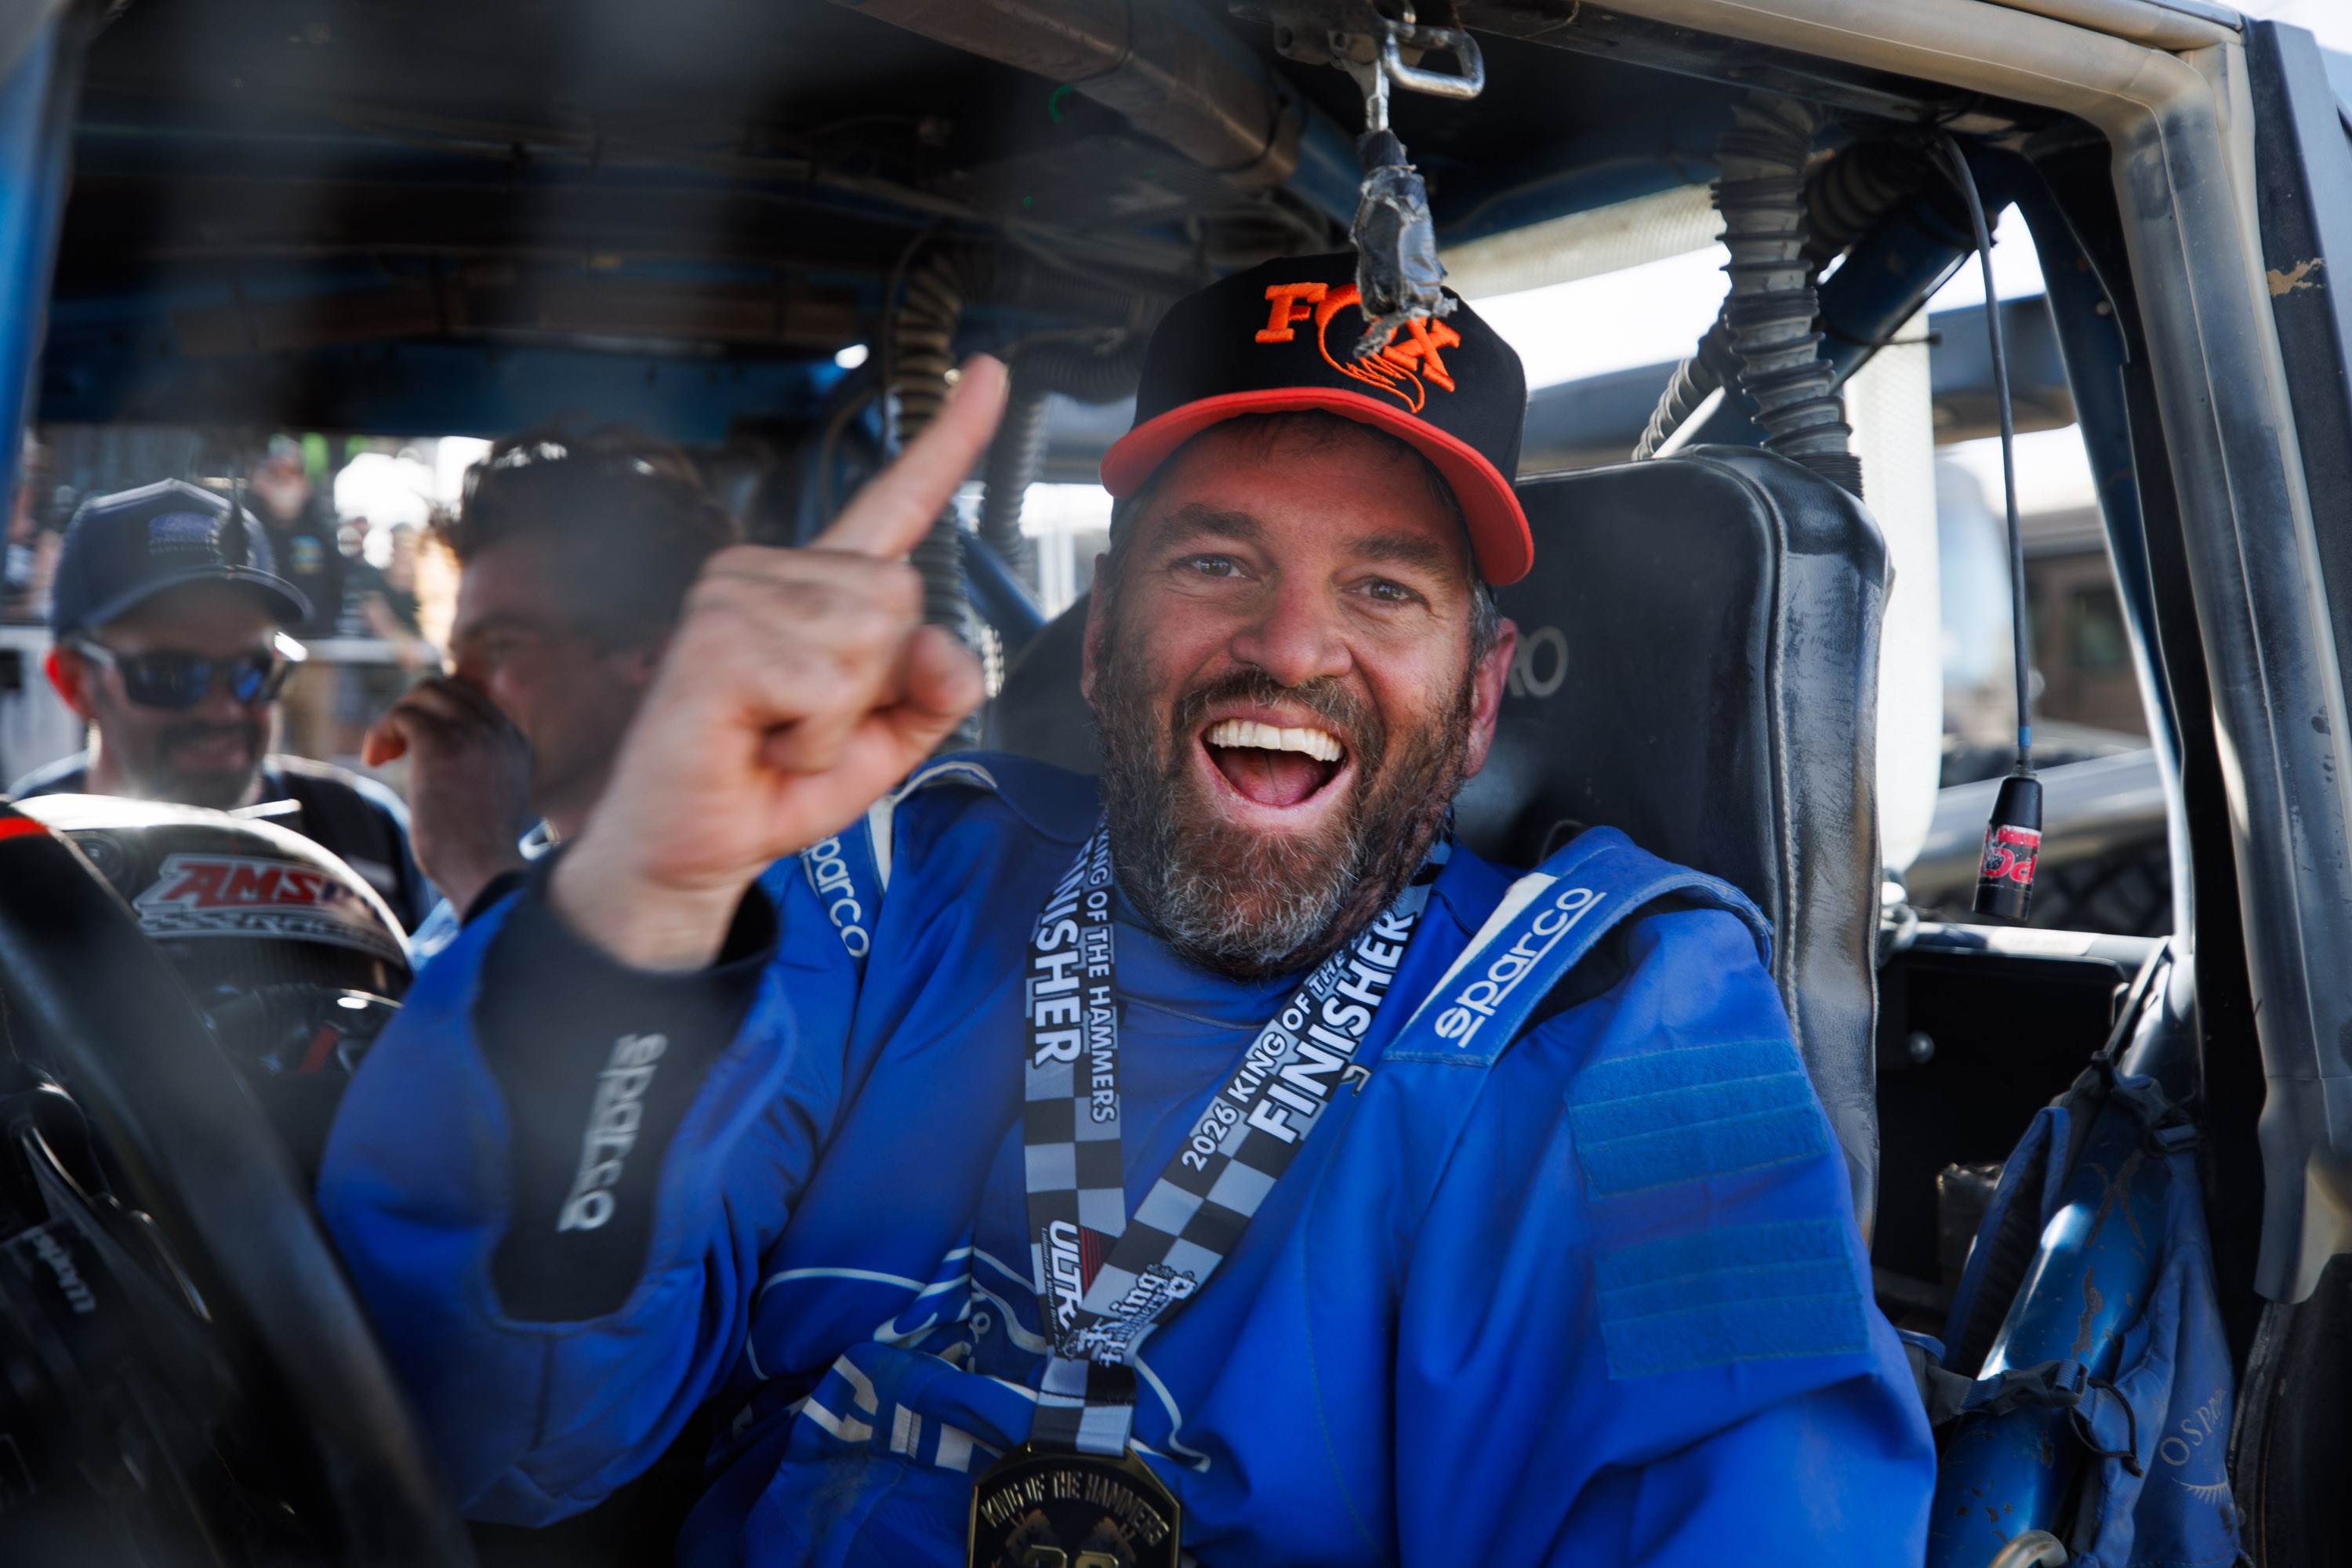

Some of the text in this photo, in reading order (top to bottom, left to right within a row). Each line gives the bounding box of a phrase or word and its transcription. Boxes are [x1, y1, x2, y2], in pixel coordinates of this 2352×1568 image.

[1255, 282, 1461, 414] FOX
[800, 835, 869, 958] parco
[1035, 835, 1094, 1067] FINISHER
[1087, 891, 1108, 921] OF
[1087, 928, 1109, 978] THE
[1247, 909, 1415, 1145] FINISHER
[1435, 887, 1599, 1043] sparco
[1089, 985, 1116, 1123] HAMMERS
[1181, 1104, 1239, 1171] 2026
[1227, 1033, 1287, 1102] KING
[1283, 993, 1311, 1031] OF
[1050, 1220, 1083, 1332] ULTR
[981, 1471, 1170, 1548] KING OF THE HAMMERS
